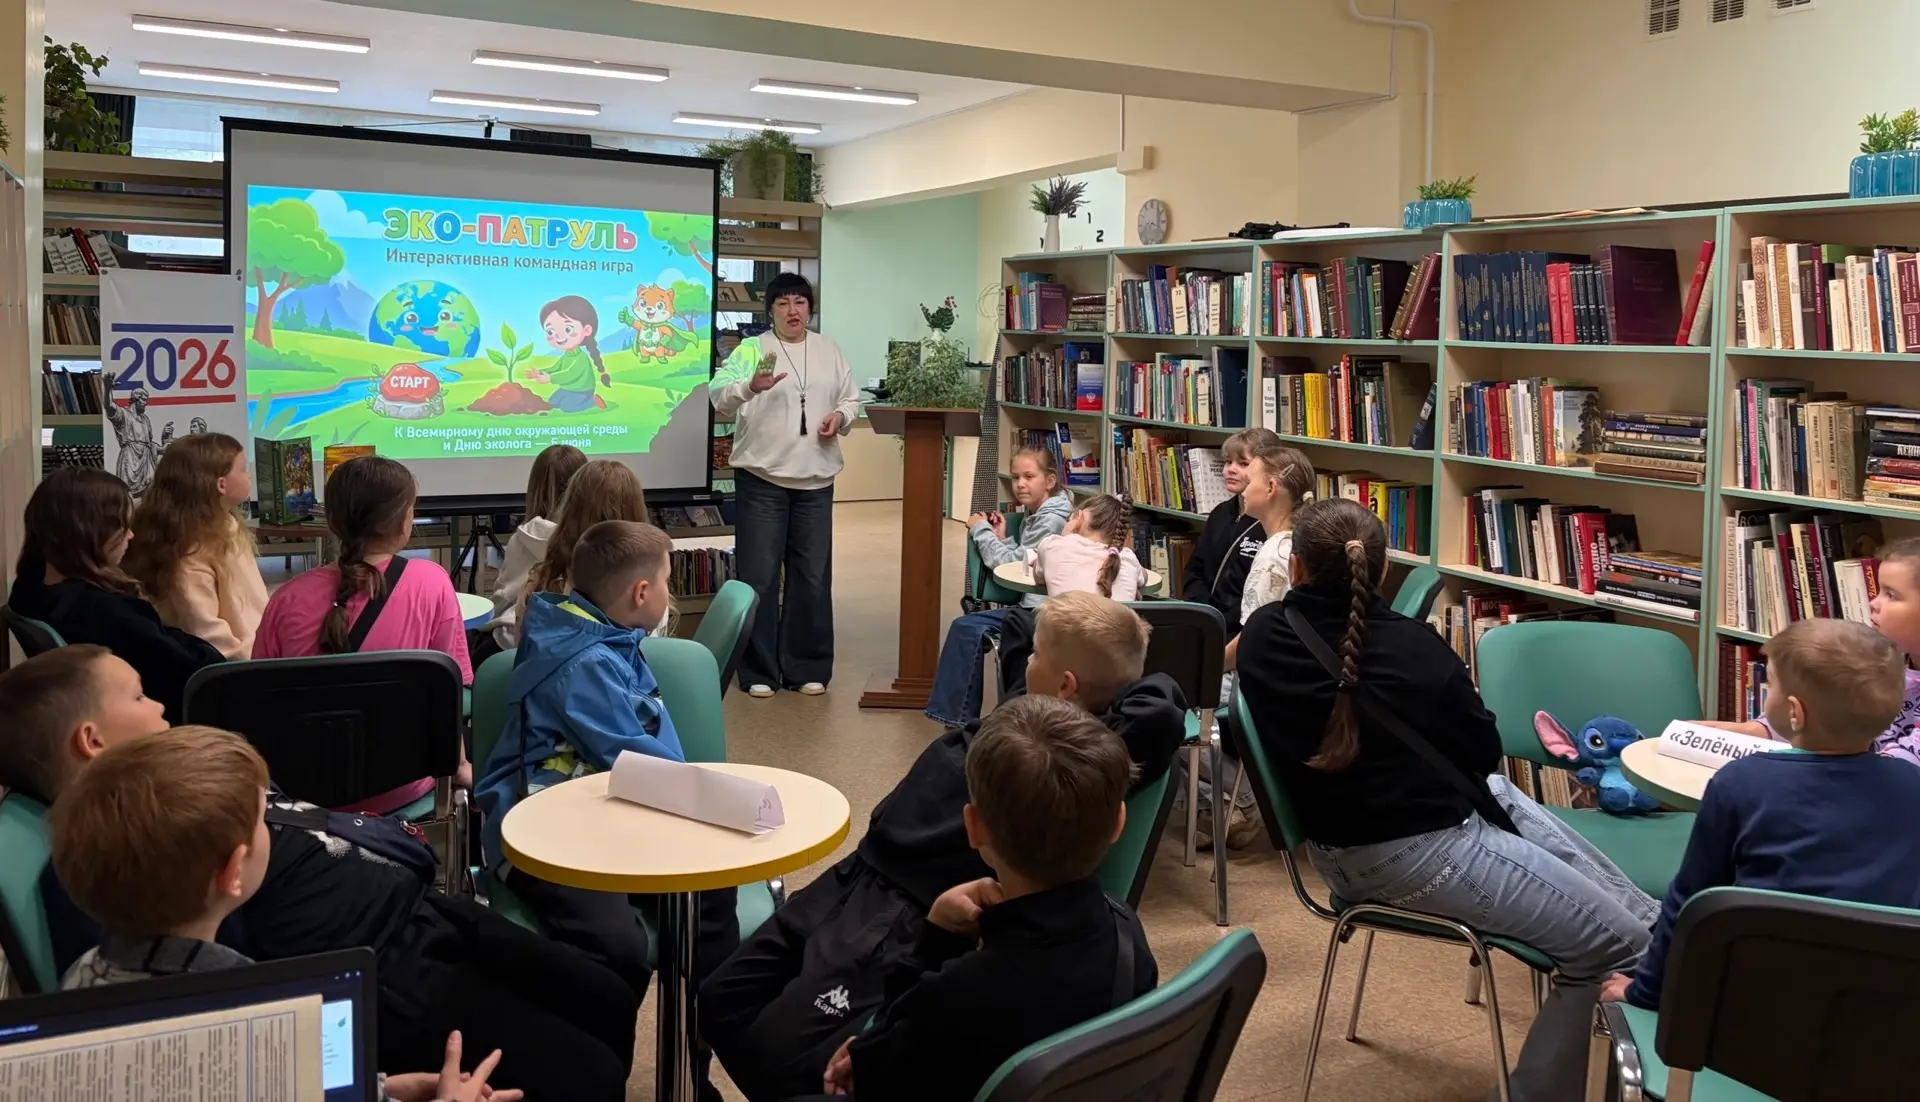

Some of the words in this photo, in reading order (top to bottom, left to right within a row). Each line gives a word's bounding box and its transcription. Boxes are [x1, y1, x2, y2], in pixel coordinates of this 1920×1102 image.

[382, 208, 637, 251] ЭКО-ПАТРУЛЬ
[1096, 229, 1104, 243] 2
[387, 248, 509, 267] Интерактивная
[514, 255, 597, 272] командная
[602, 260, 634, 275] игра
[110, 338, 236, 390] 2026
[390, 375, 430, 388] СТАРТ
[394, 426, 403, 438] К
[407, 426, 484, 440] Всемирному
[486, 427, 513, 438] дню
[515, 424, 590, 438] окружающей
[592, 425, 628, 437] среды
[443, 441, 451, 451] и
[454, 439, 482, 452] Дню
[485, 440, 532, 449] эколога
[562, 437, 592, 447] июня
[1669, 730, 1761, 760] «Зелёный
